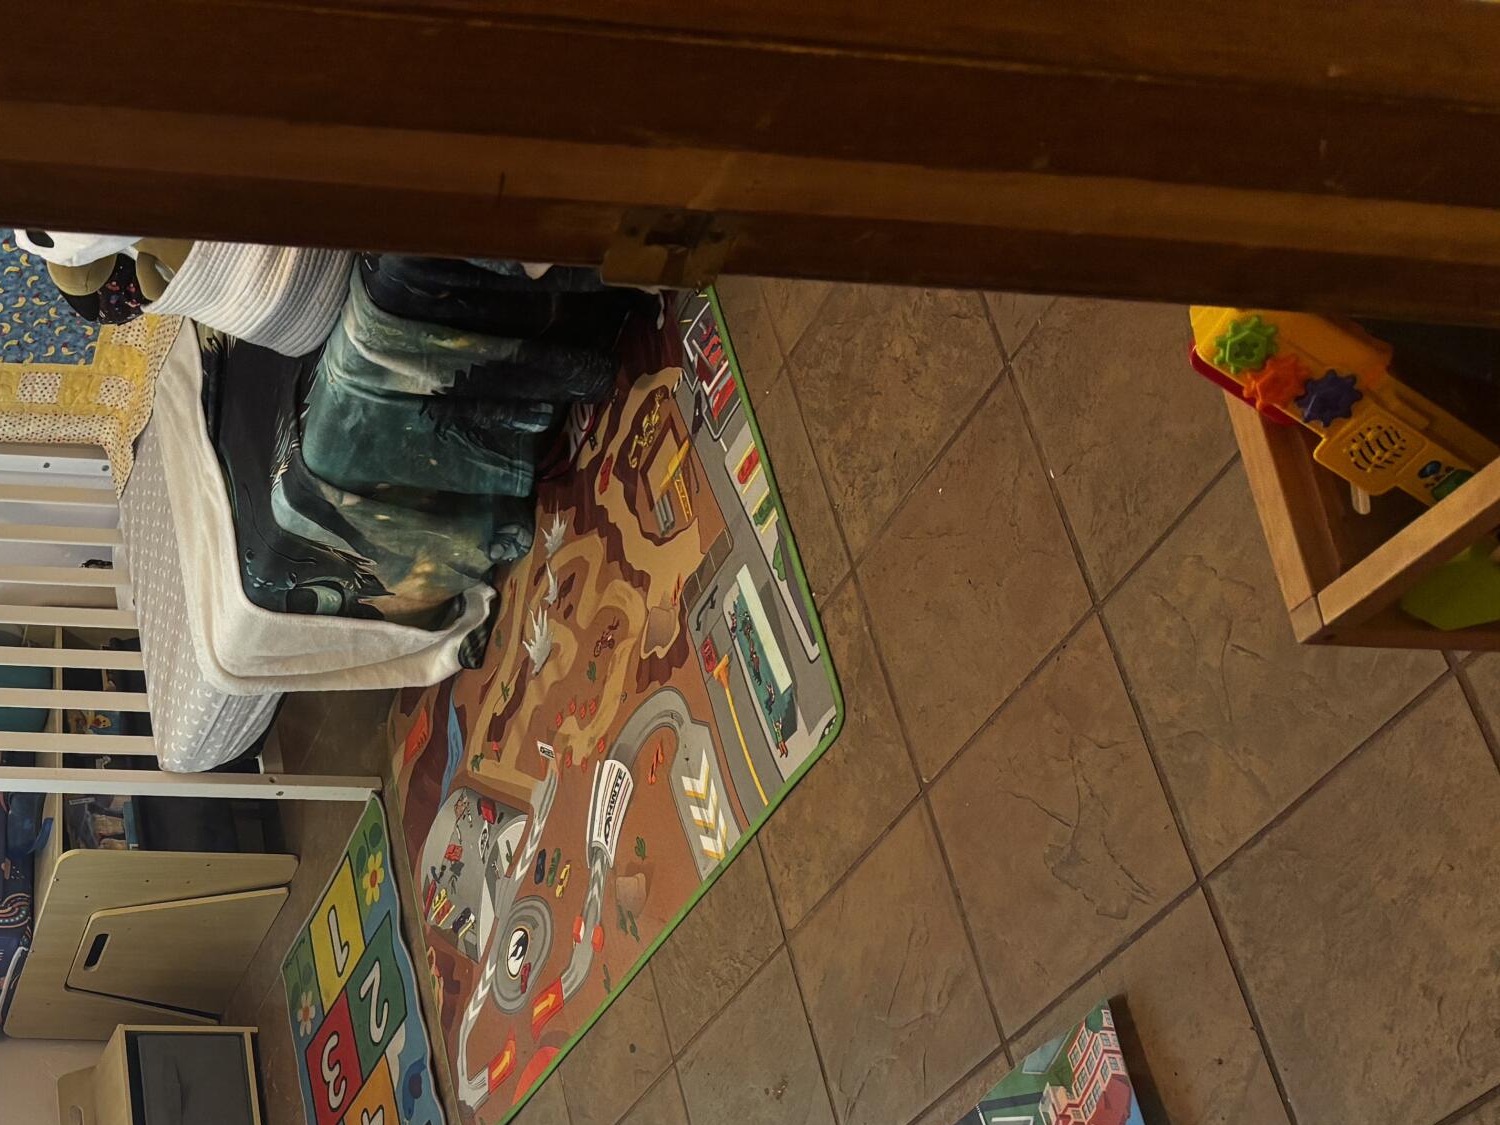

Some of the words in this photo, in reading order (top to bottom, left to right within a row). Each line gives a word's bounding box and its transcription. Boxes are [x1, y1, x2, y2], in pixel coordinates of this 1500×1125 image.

[328, 907, 350, 977] 1
[360, 960, 391, 1045] 2
[319, 1030, 348, 1111] 3
